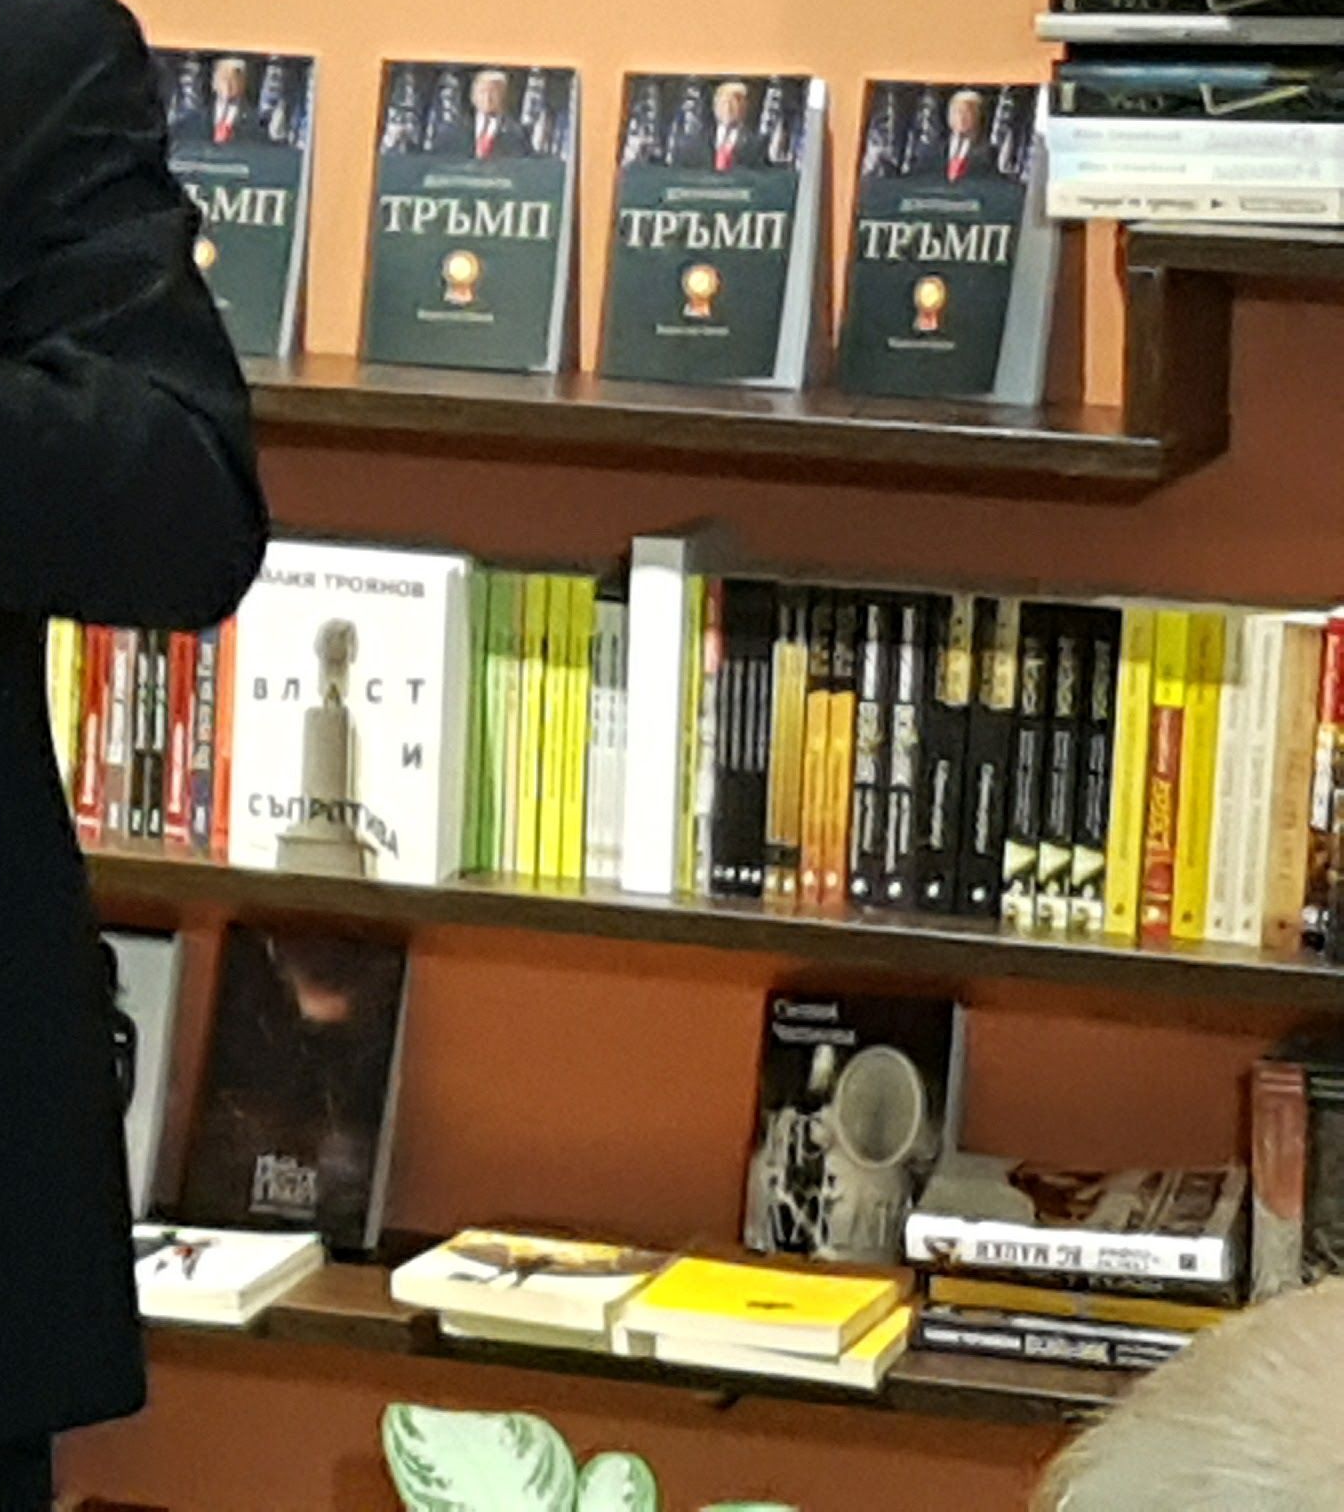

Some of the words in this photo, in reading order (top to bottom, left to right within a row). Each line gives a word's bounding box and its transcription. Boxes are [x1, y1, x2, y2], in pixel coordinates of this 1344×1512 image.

[184, 182, 287, 227] ЪМП
[378, 193, 551, 240] ТРЪМП
[619, 207, 787, 251] ТРЪМП
[858, 219, 1012, 265] ТРЪМП
[401, 743, 423, 770] И
